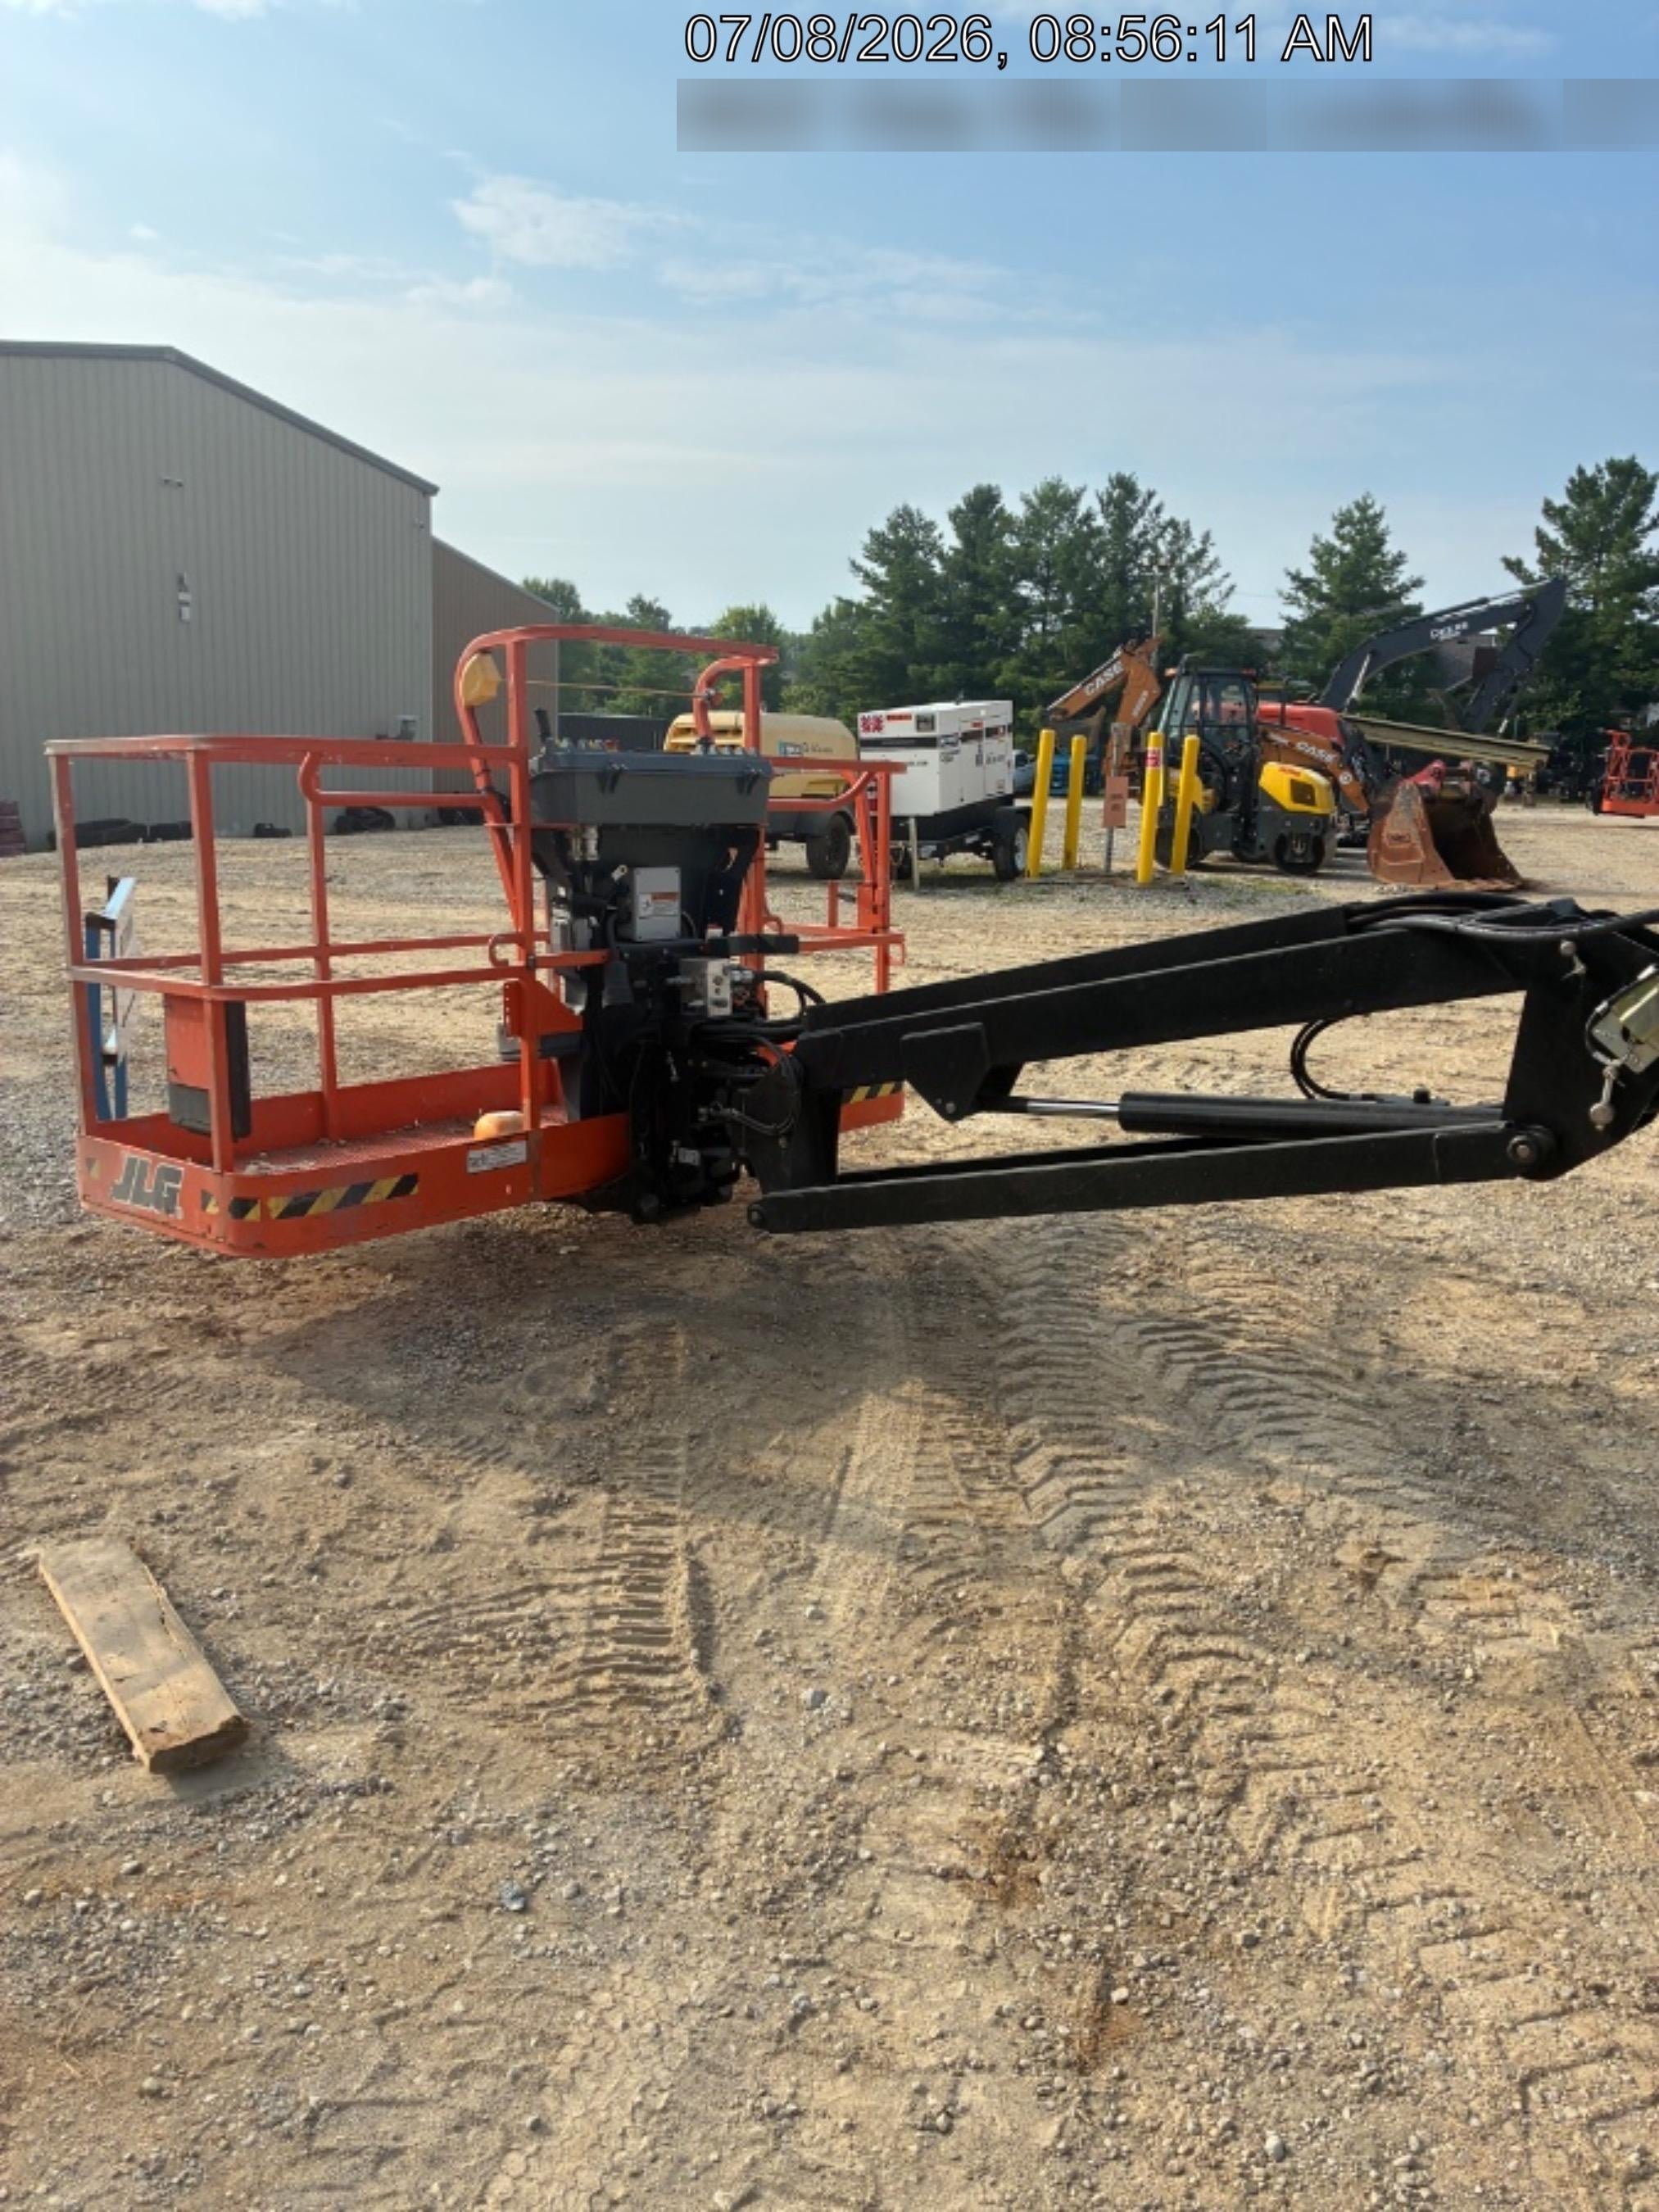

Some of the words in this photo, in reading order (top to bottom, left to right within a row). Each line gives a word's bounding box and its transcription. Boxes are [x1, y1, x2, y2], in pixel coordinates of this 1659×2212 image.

[1085, 660, 1124, 696] CASE
[1295, 741, 1336, 763] CASE
[111, 1154, 184, 1217] JLG
